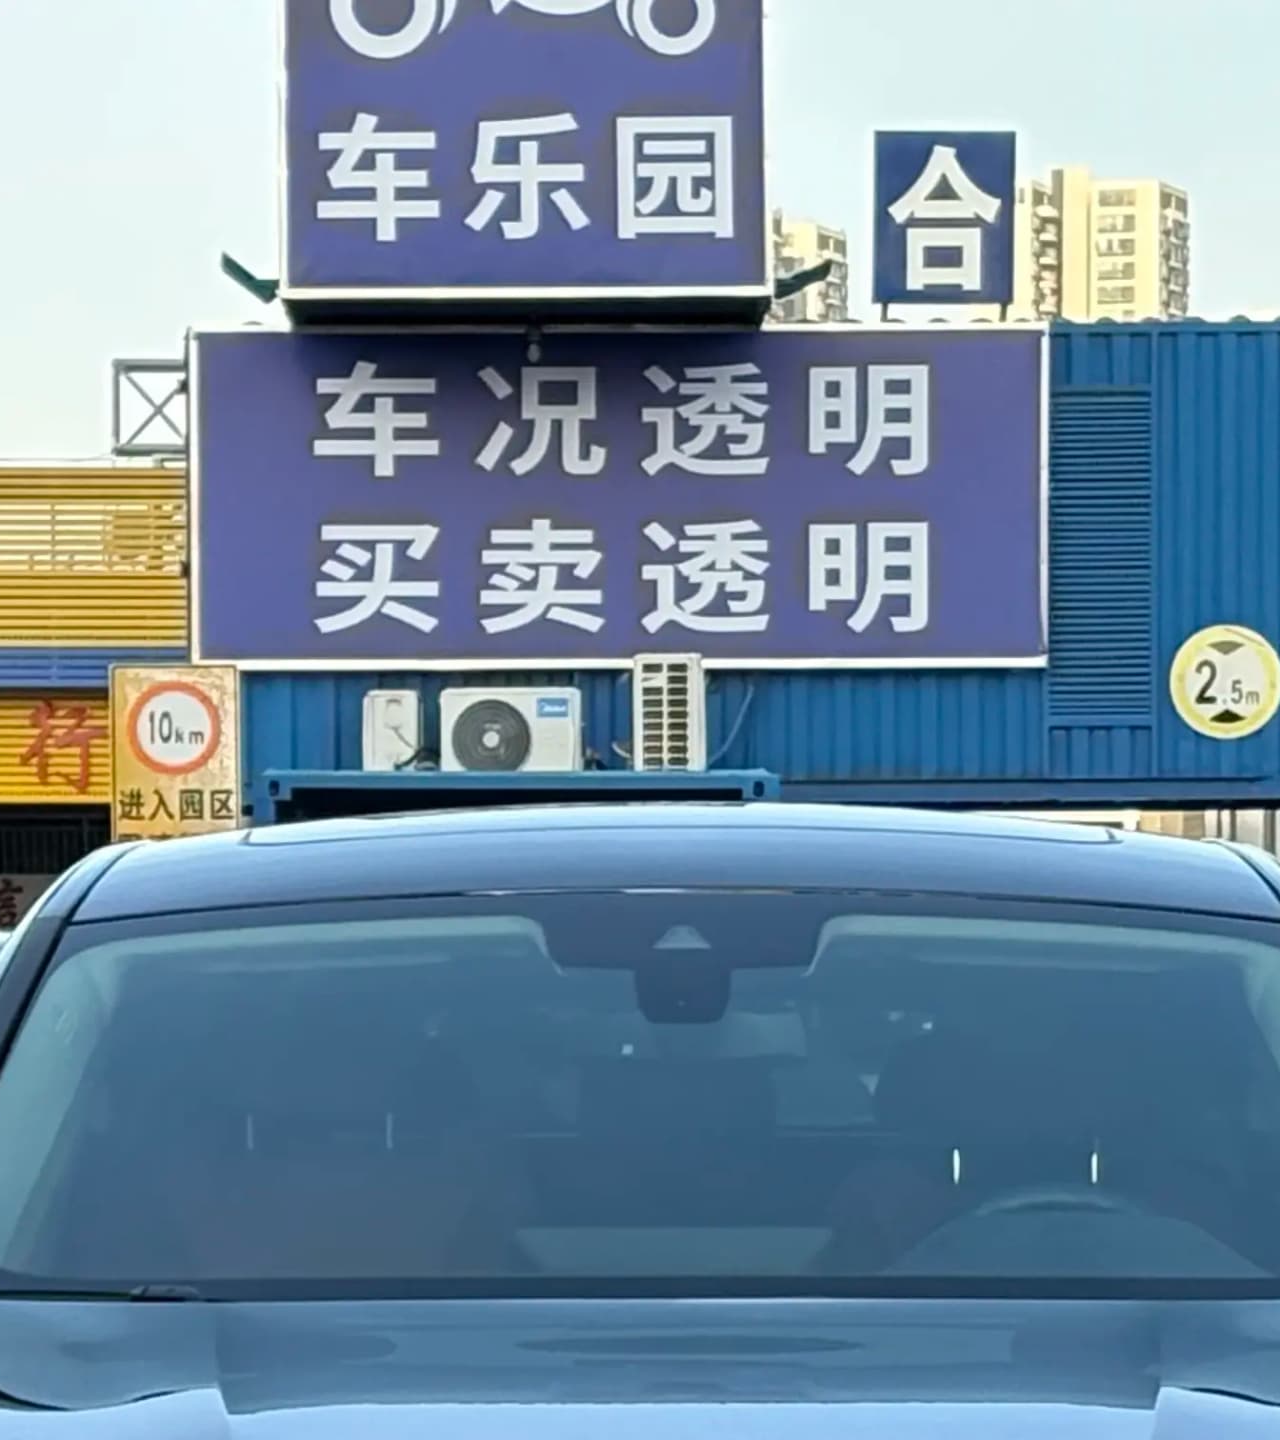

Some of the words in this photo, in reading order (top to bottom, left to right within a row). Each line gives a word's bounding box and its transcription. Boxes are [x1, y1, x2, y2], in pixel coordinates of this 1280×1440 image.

[315, 112, 736, 242] 车乐园
[887, 144, 1003, 292] 合
[313, 362, 930, 478] 车况透明
[313, 518, 930, 635] 买卖透明
[1194, 659, 1260, 706] 2.5m
[118, 788, 234, 821] 进入园区
